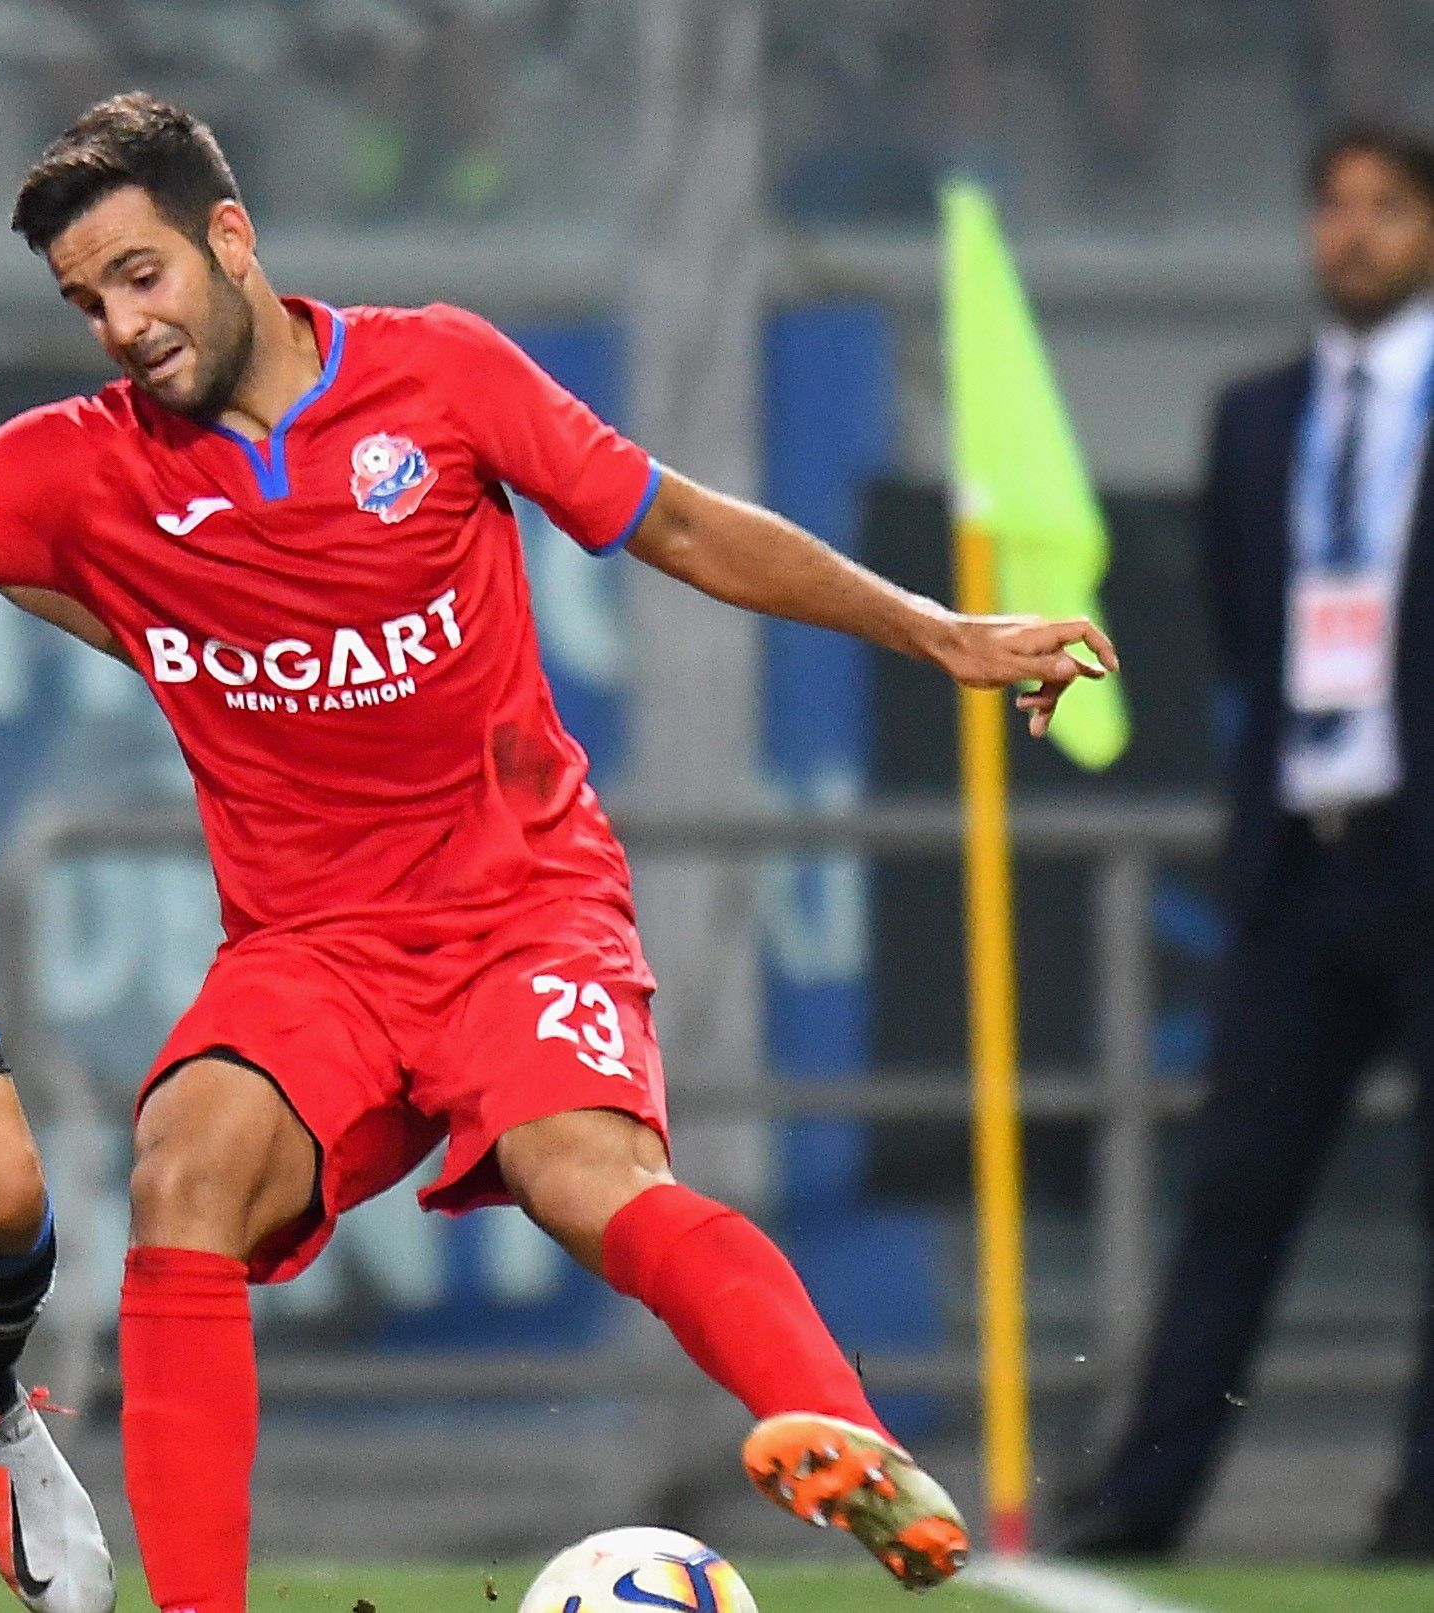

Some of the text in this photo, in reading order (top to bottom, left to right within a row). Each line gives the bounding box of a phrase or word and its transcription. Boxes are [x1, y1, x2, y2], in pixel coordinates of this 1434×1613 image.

[145, 588, 462, 691] BOGART
[225, 676, 416, 713] MEN'S FASHION
[532, 974, 625, 1060] 23
